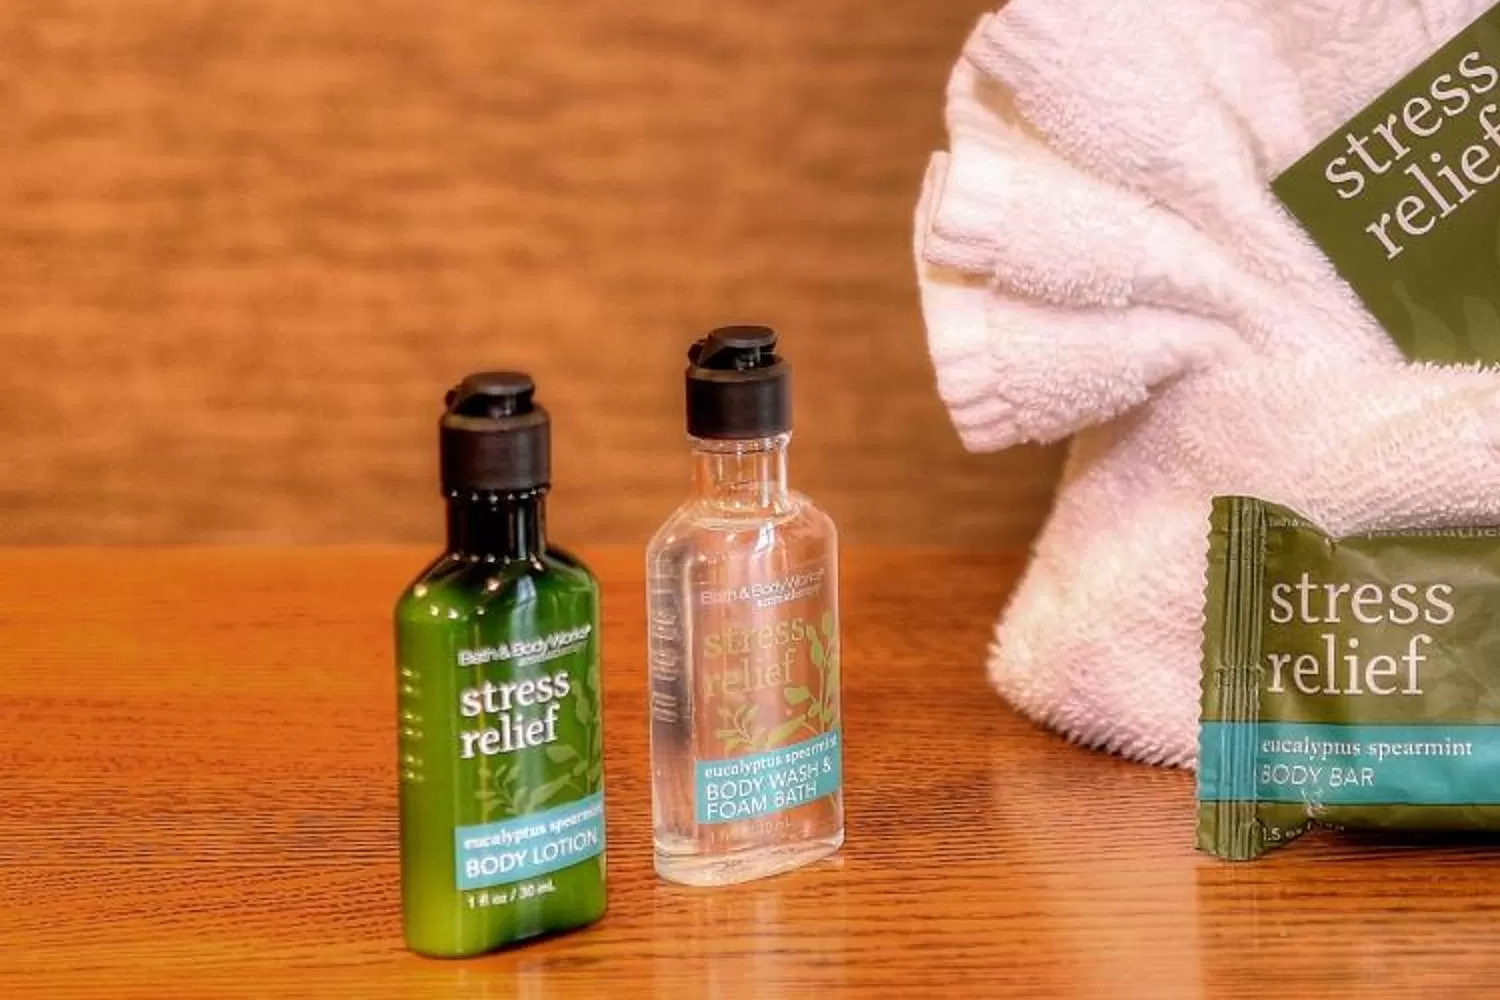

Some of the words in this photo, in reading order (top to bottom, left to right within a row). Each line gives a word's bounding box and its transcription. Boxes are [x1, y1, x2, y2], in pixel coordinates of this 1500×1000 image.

[1325, 51, 1499, 199] stress
[1270, 572, 1455, 625] stress
[704, 615, 805, 658] stress
[704, 648, 798, 699] relief
[1266, 634, 1433, 697] relief
[460, 669, 571, 717] stress
[460, 704, 561, 759] relief
[1262, 736, 1361, 761] eucalyptus
[1368, 737, 1473, 763] spearmint
[705, 755, 781, 778] eucalyptus
[706, 776, 765, 801] BODY
[769, 761, 819, 789] WASH
[1261, 764, 1324, 785] BODY
[1329, 767, 1376, 787] BAR
[707, 794, 767, 821] FOAM
[775, 780, 817, 808] BATH
[465, 849, 528, 879] BODY
[533, 826, 597, 865] LOTION
[467, 895, 476, 910] 1
